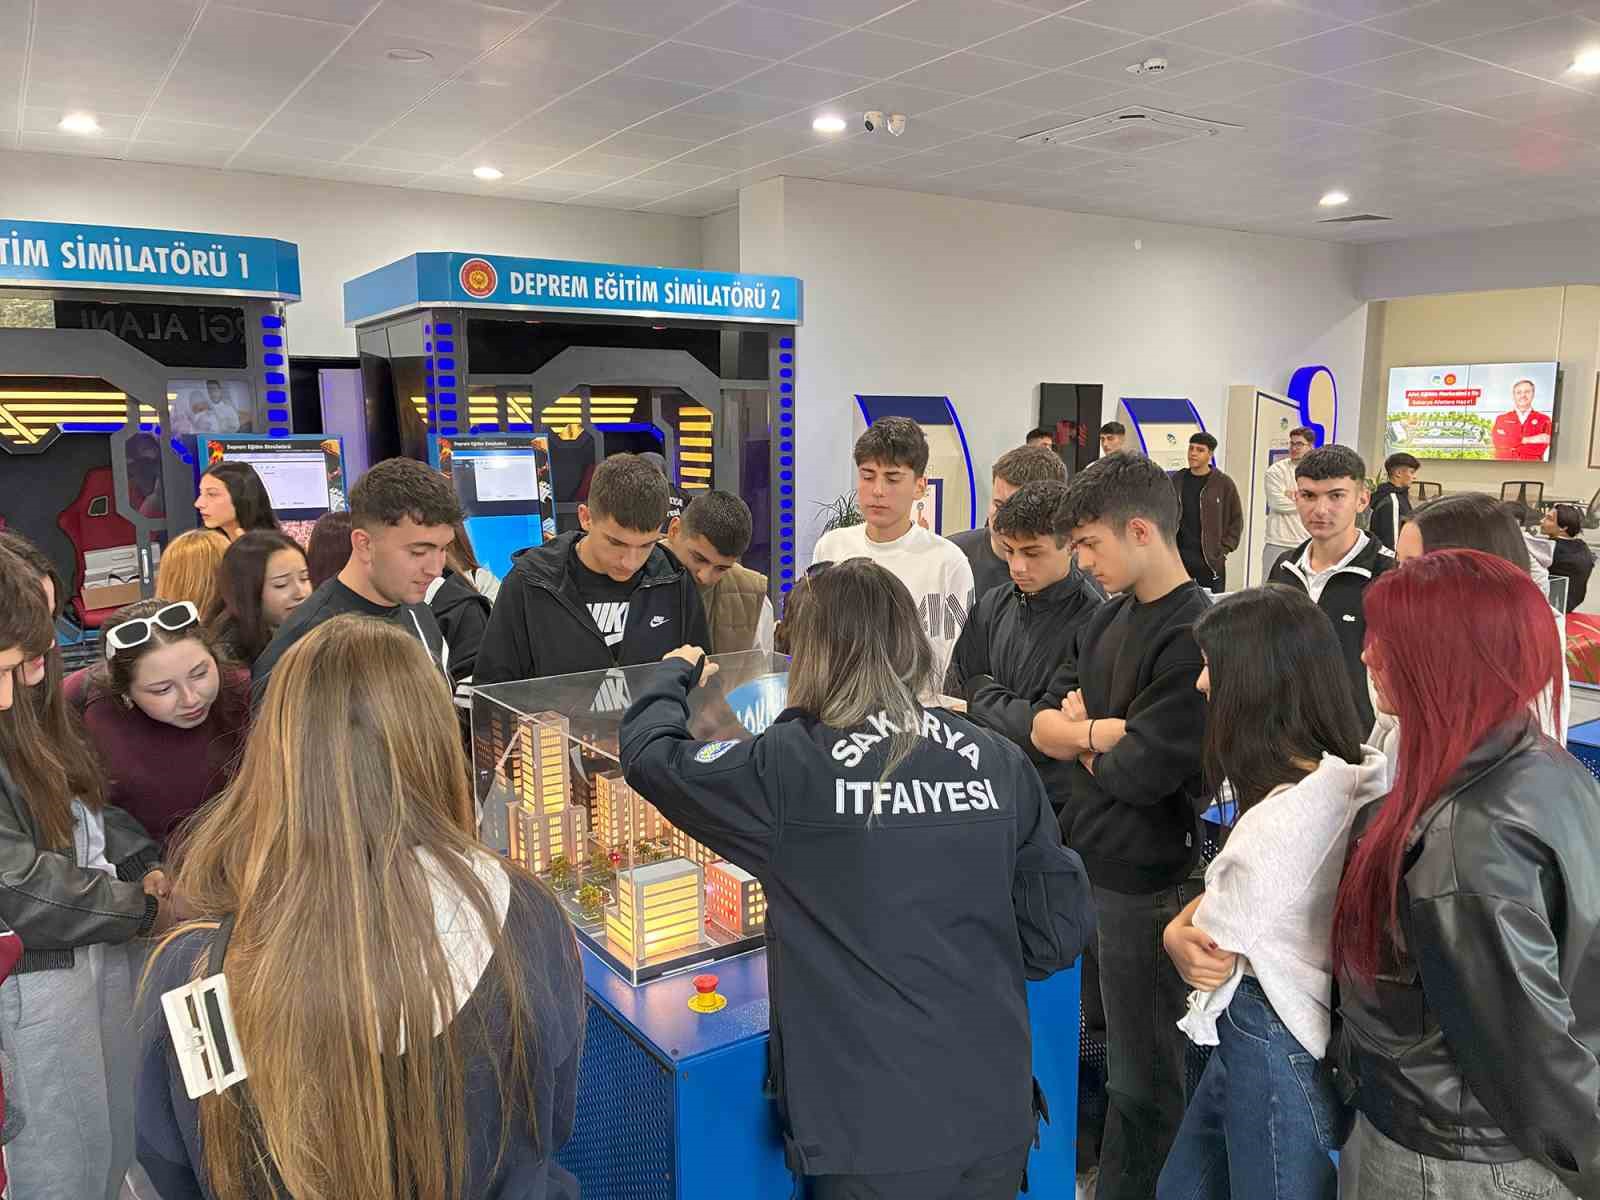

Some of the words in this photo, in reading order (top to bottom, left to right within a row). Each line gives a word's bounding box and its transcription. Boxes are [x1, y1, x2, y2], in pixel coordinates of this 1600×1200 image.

[60, 234, 228, 277] SİMİLATÖRÜ
[238, 252, 249, 279] 1
[510, 271, 589, 298] DEPREM
[594, 271, 658, 304] EĞİTİM
[664, 276, 766, 310] SİMİLATÖRÜ
[771, 289, 781, 310] 2
